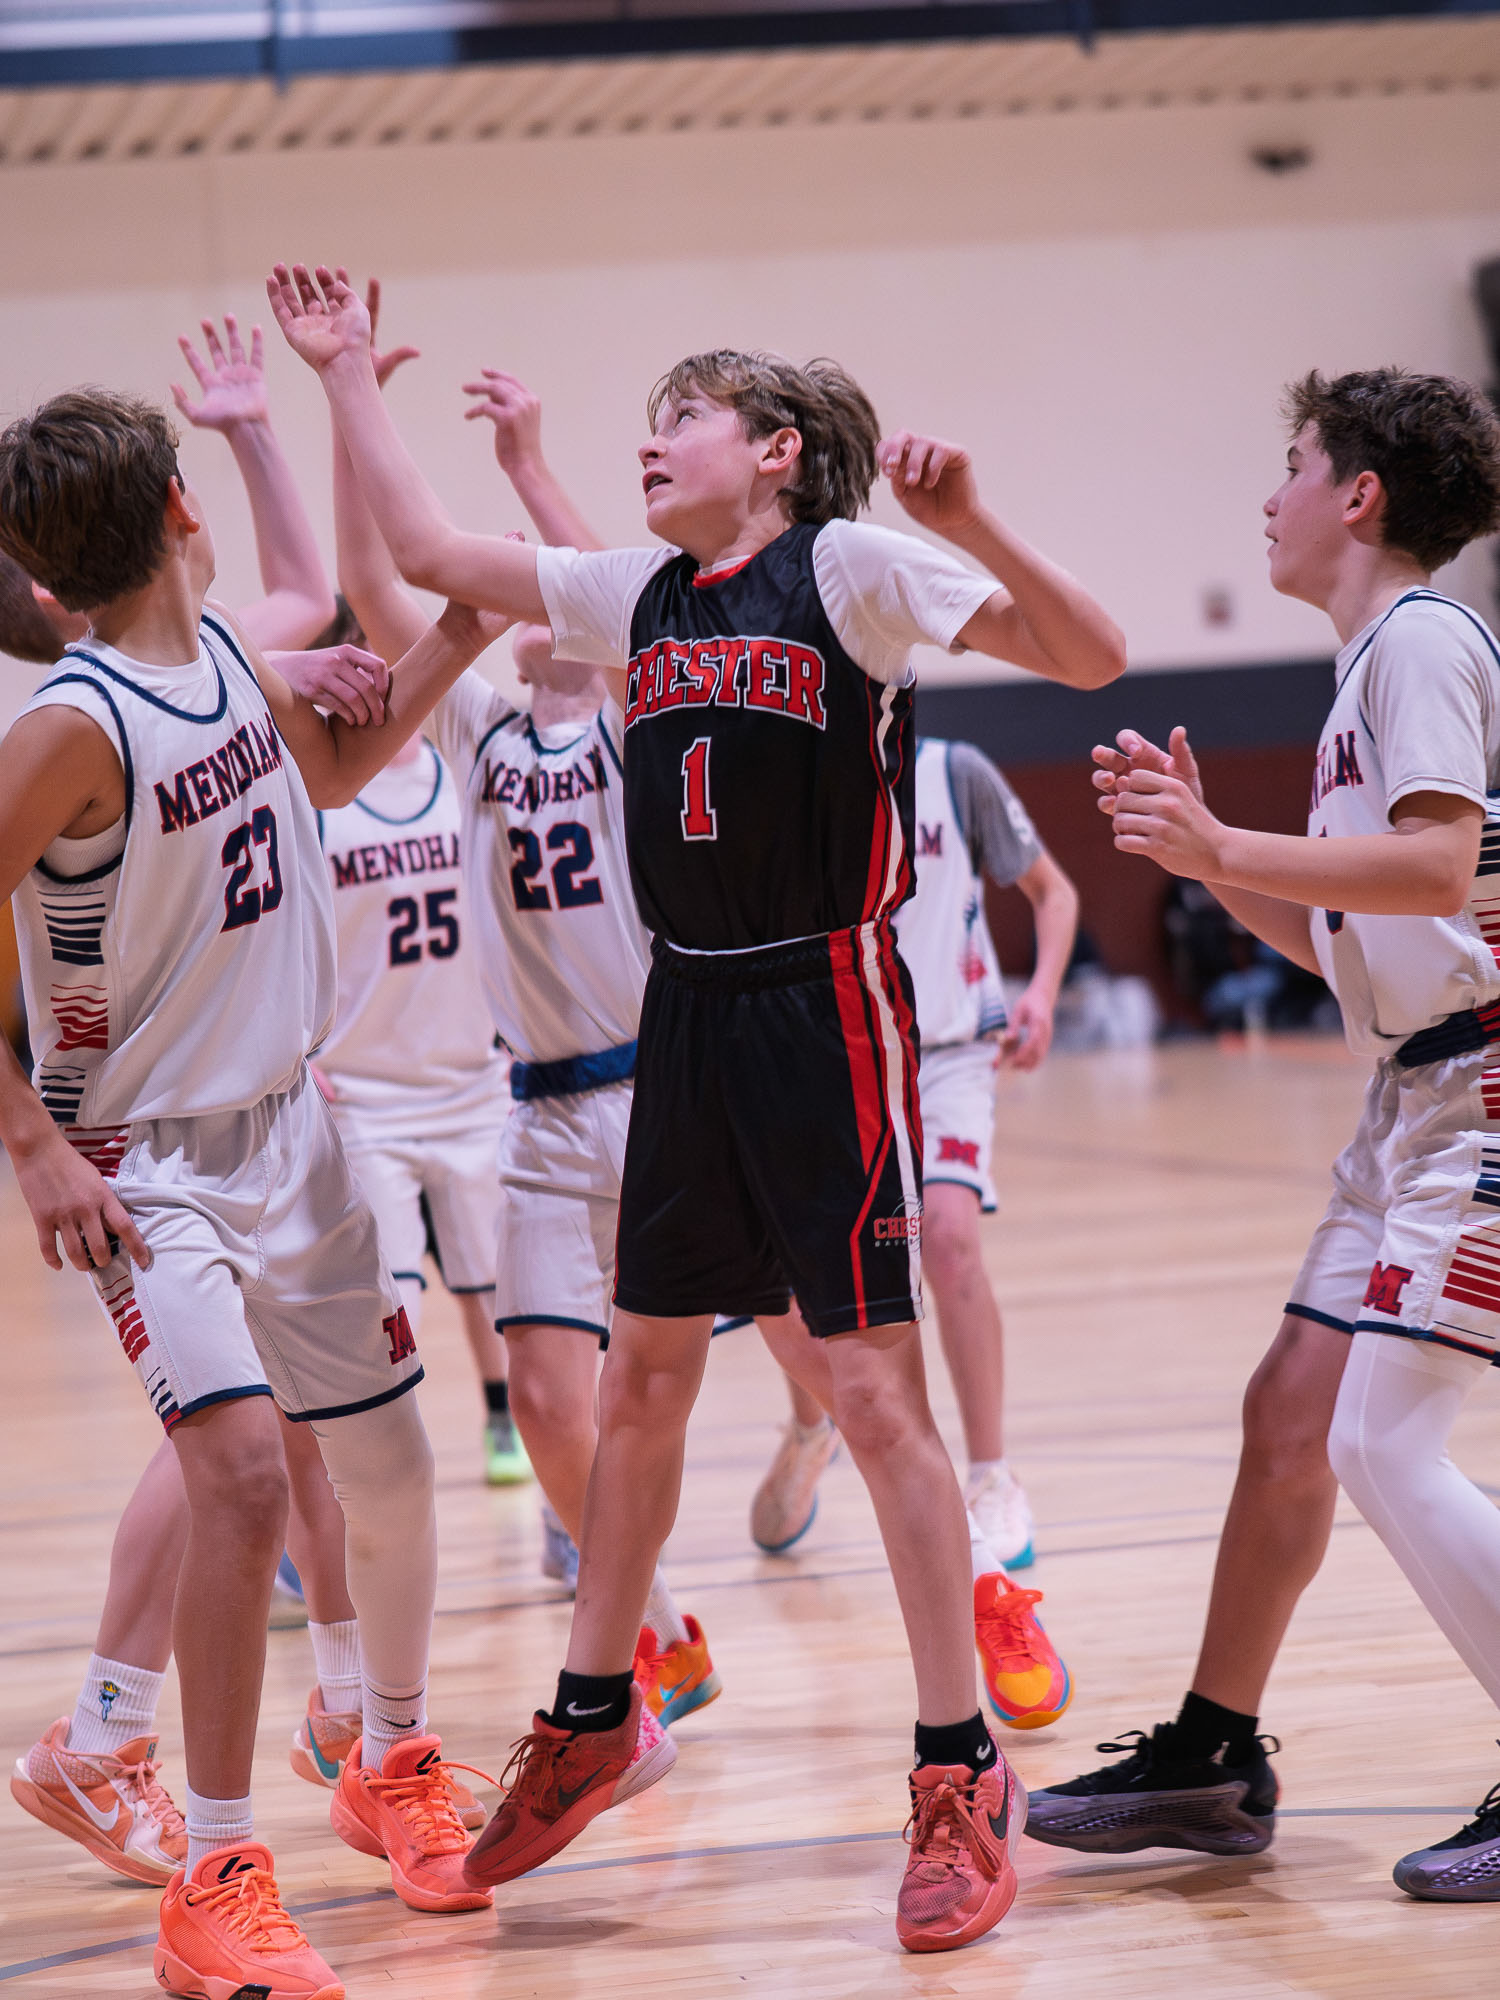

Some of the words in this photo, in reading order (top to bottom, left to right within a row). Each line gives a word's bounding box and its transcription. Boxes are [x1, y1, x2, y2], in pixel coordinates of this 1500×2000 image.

[625, 635, 827, 732] CHESTER
[681, 736, 718, 842] 1
[220, 803, 284, 934] 23
[507, 821, 605, 913] 22
[387, 887, 460, 969] 25
